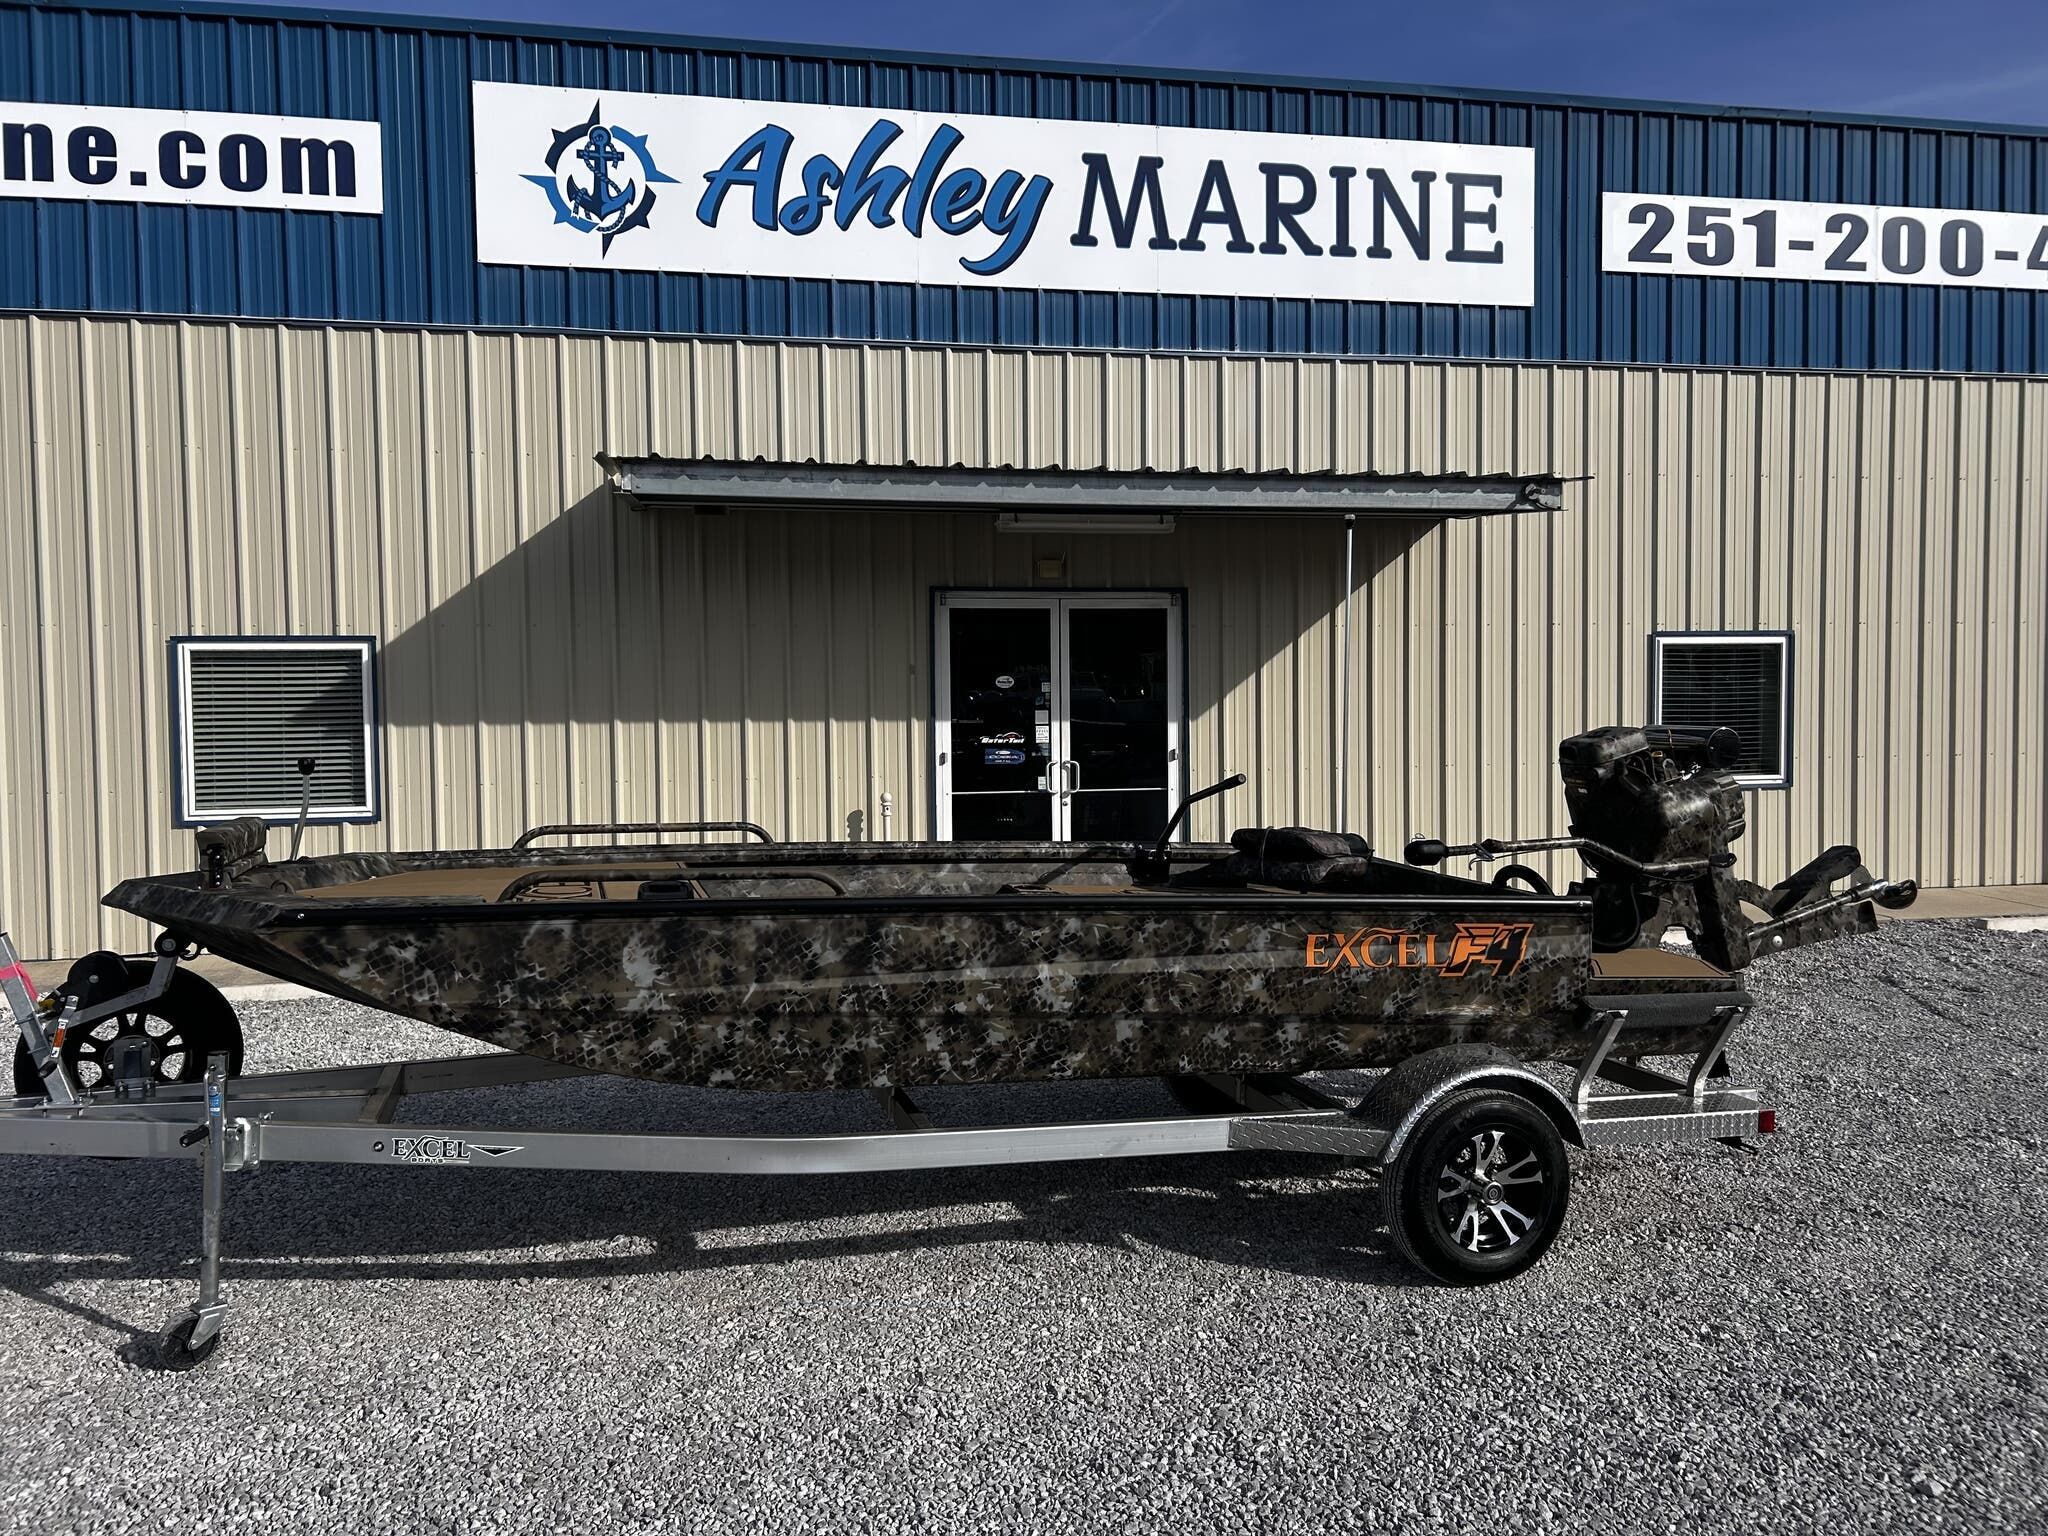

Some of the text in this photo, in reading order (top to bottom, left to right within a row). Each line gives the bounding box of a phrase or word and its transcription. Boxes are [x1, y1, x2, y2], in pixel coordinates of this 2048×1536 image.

[2, 122, 357, 198] ne.com
[695, 118, 1504, 276] Ashley MARINE
[1304, 926, 1450, 975] EXCEL
[391, 1135, 471, 1160] EXCEL
